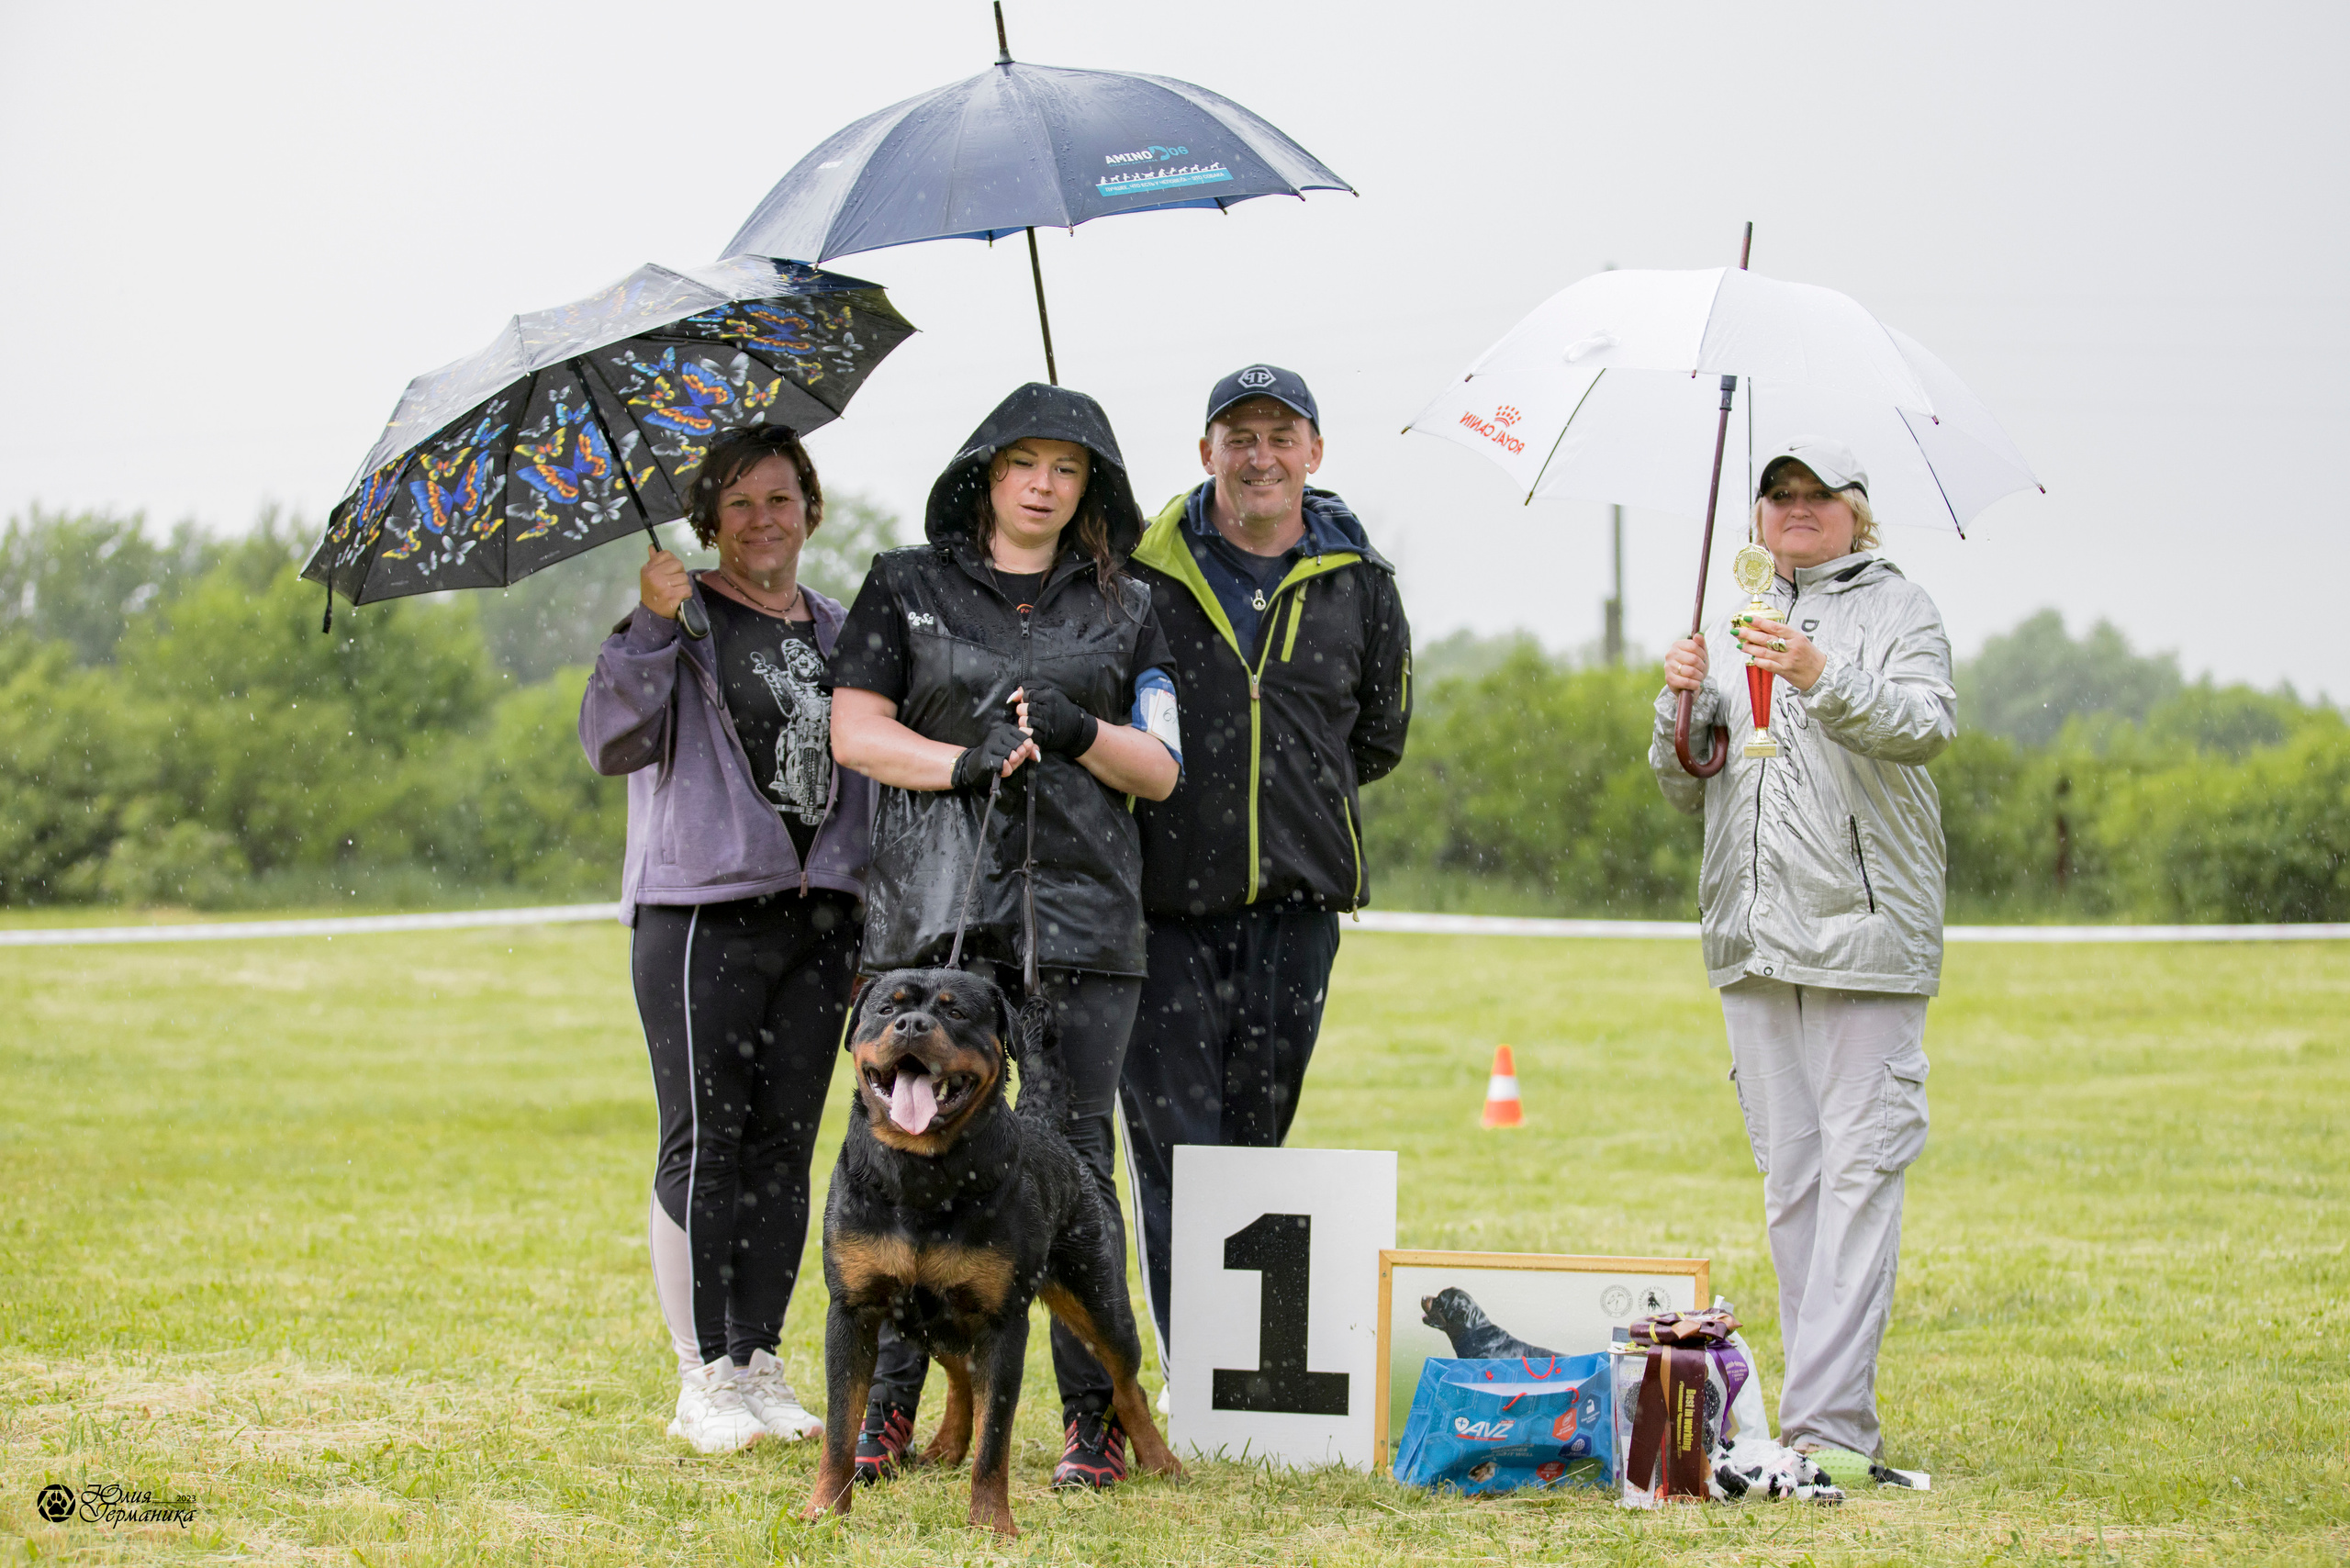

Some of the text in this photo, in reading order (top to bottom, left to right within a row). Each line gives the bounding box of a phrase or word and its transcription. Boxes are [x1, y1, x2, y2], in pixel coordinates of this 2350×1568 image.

[1212, 1213, 1349, 1416] 1
[1460, 1420, 1514, 1438] AVZ
[1682, 1388, 1696, 1450] Best in working
